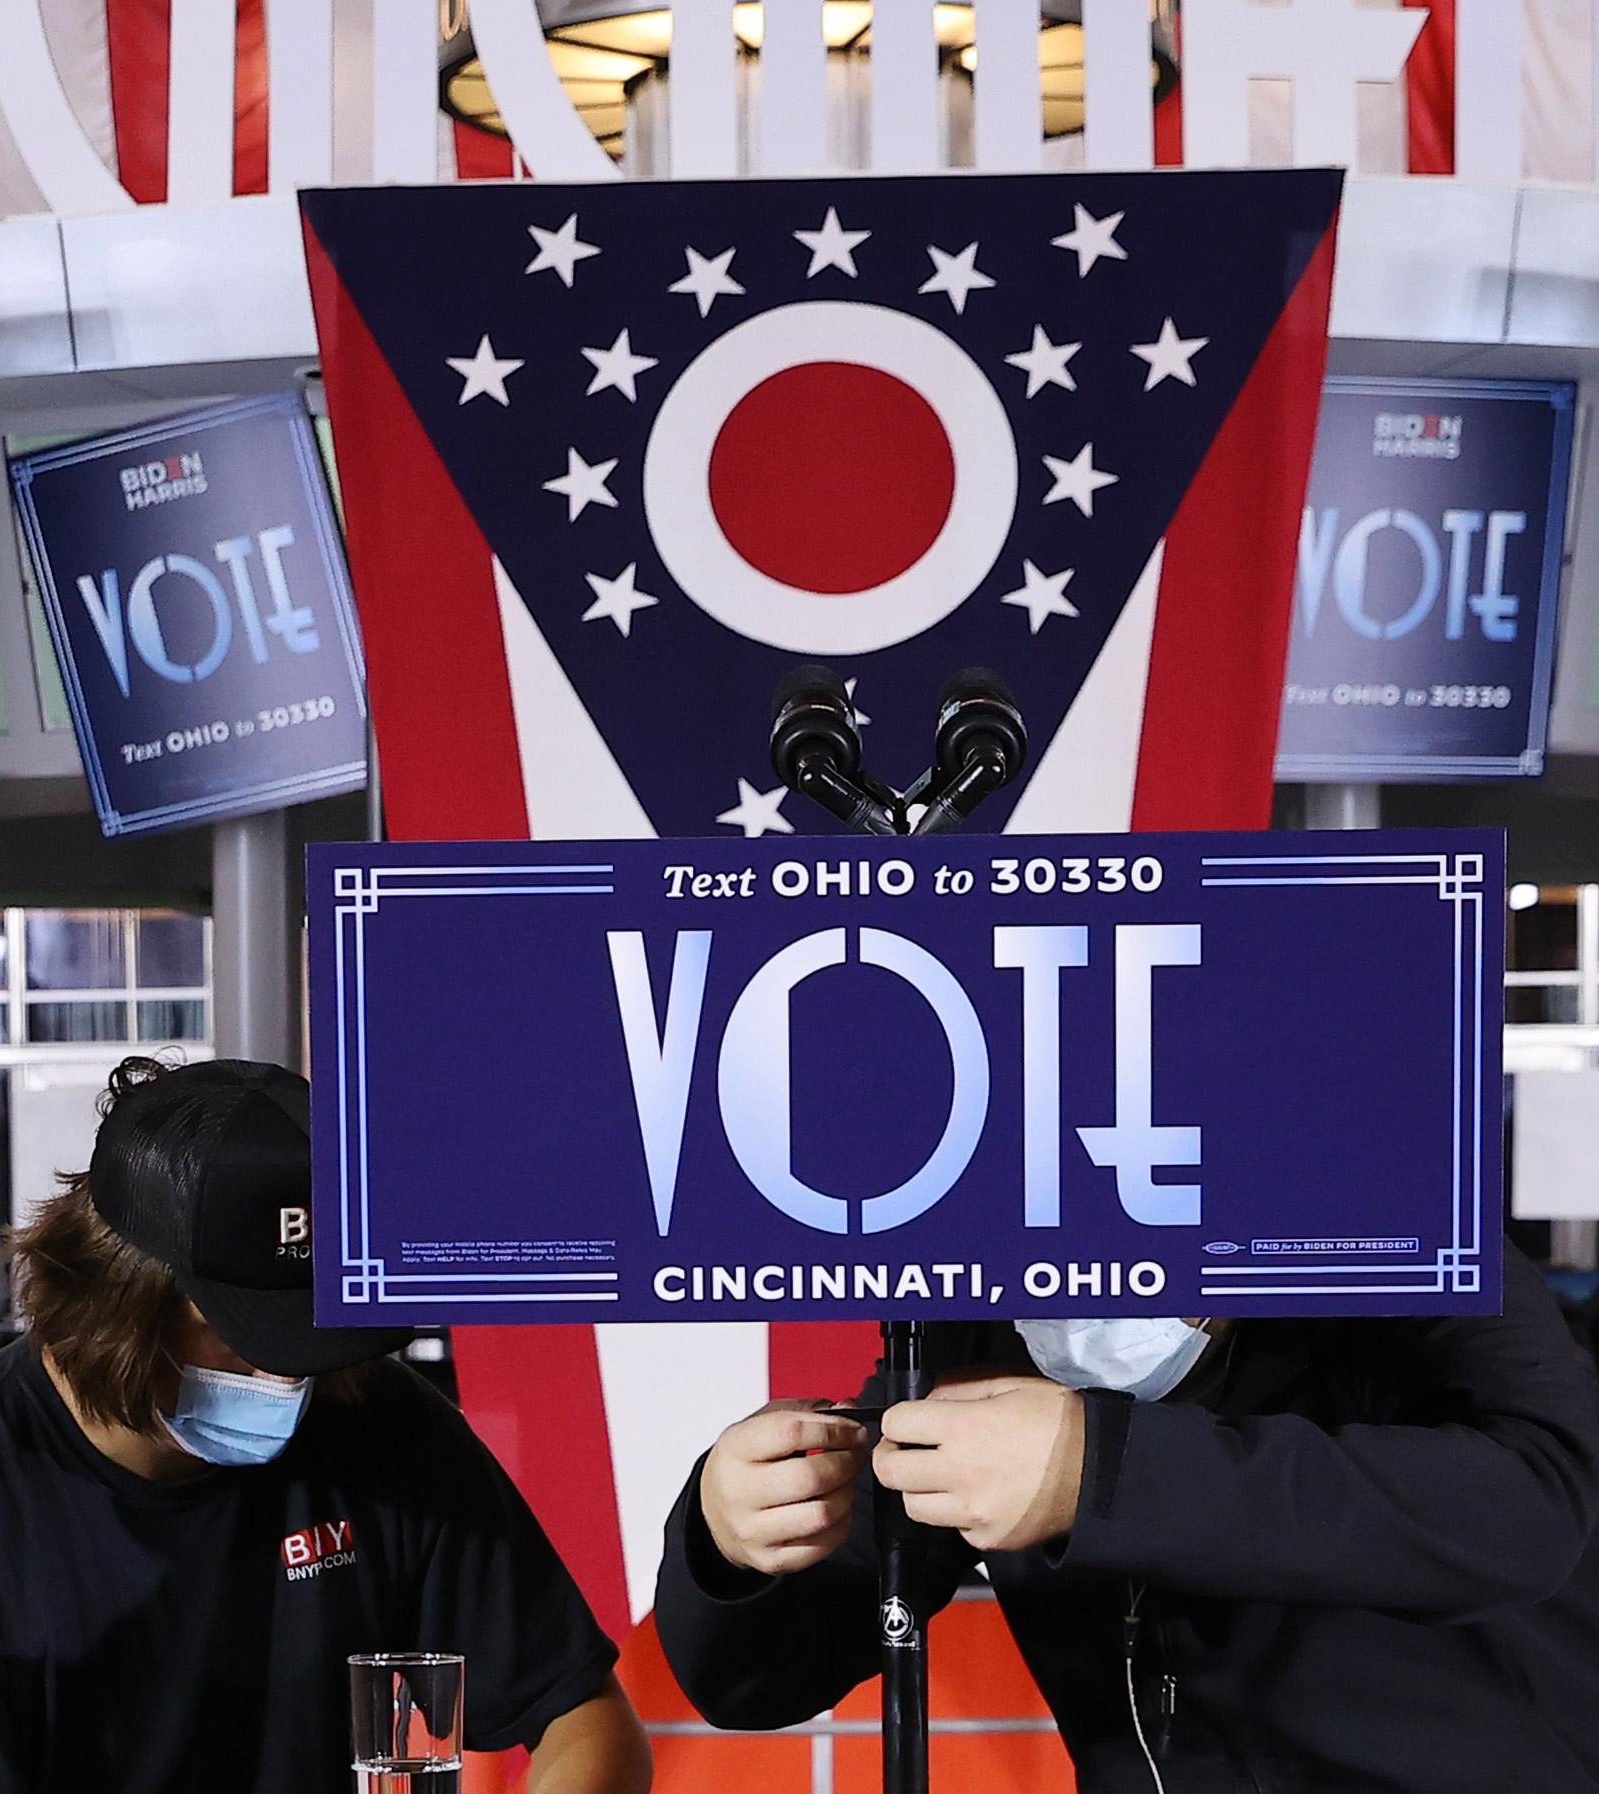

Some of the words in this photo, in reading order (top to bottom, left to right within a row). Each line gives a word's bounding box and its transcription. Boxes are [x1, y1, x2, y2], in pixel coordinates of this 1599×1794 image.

[120, 452, 203, 493] BIDEN
[124, 477, 209, 511] HARRIS
[1298, 505, 1527, 643] VOTE
[76, 524, 321, 699] VOTE
[1331, 683, 1400, 708] OHIO
[1429, 684, 1512, 709] 30330
[121, 739, 165, 765] Text
[165, 720, 231, 755] OHIO
[257, 695, 337, 733] 30330
[663, 864, 757, 899] Text
[771, 859, 916, 897] OHIO
[933, 860, 975, 895] to
[989, 856, 1164, 894] 30330
[606, 924, 1202, 1237] VOTE
[1256, 1243, 1280, 1251] PAID
[1280, 1242, 1293, 1252] for
[1293, 1243, 1303, 1252] by
[1304, 1242, 1334, 1250] BIDEN
[1336, 1242, 1356, 1250] FOR
[1358, 1241, 1415, 1250] PRESIDENT
[652, 1262, 1004, 1304] CINCINNATI,
[1023, 1260, 1167, 1298] OHIO
